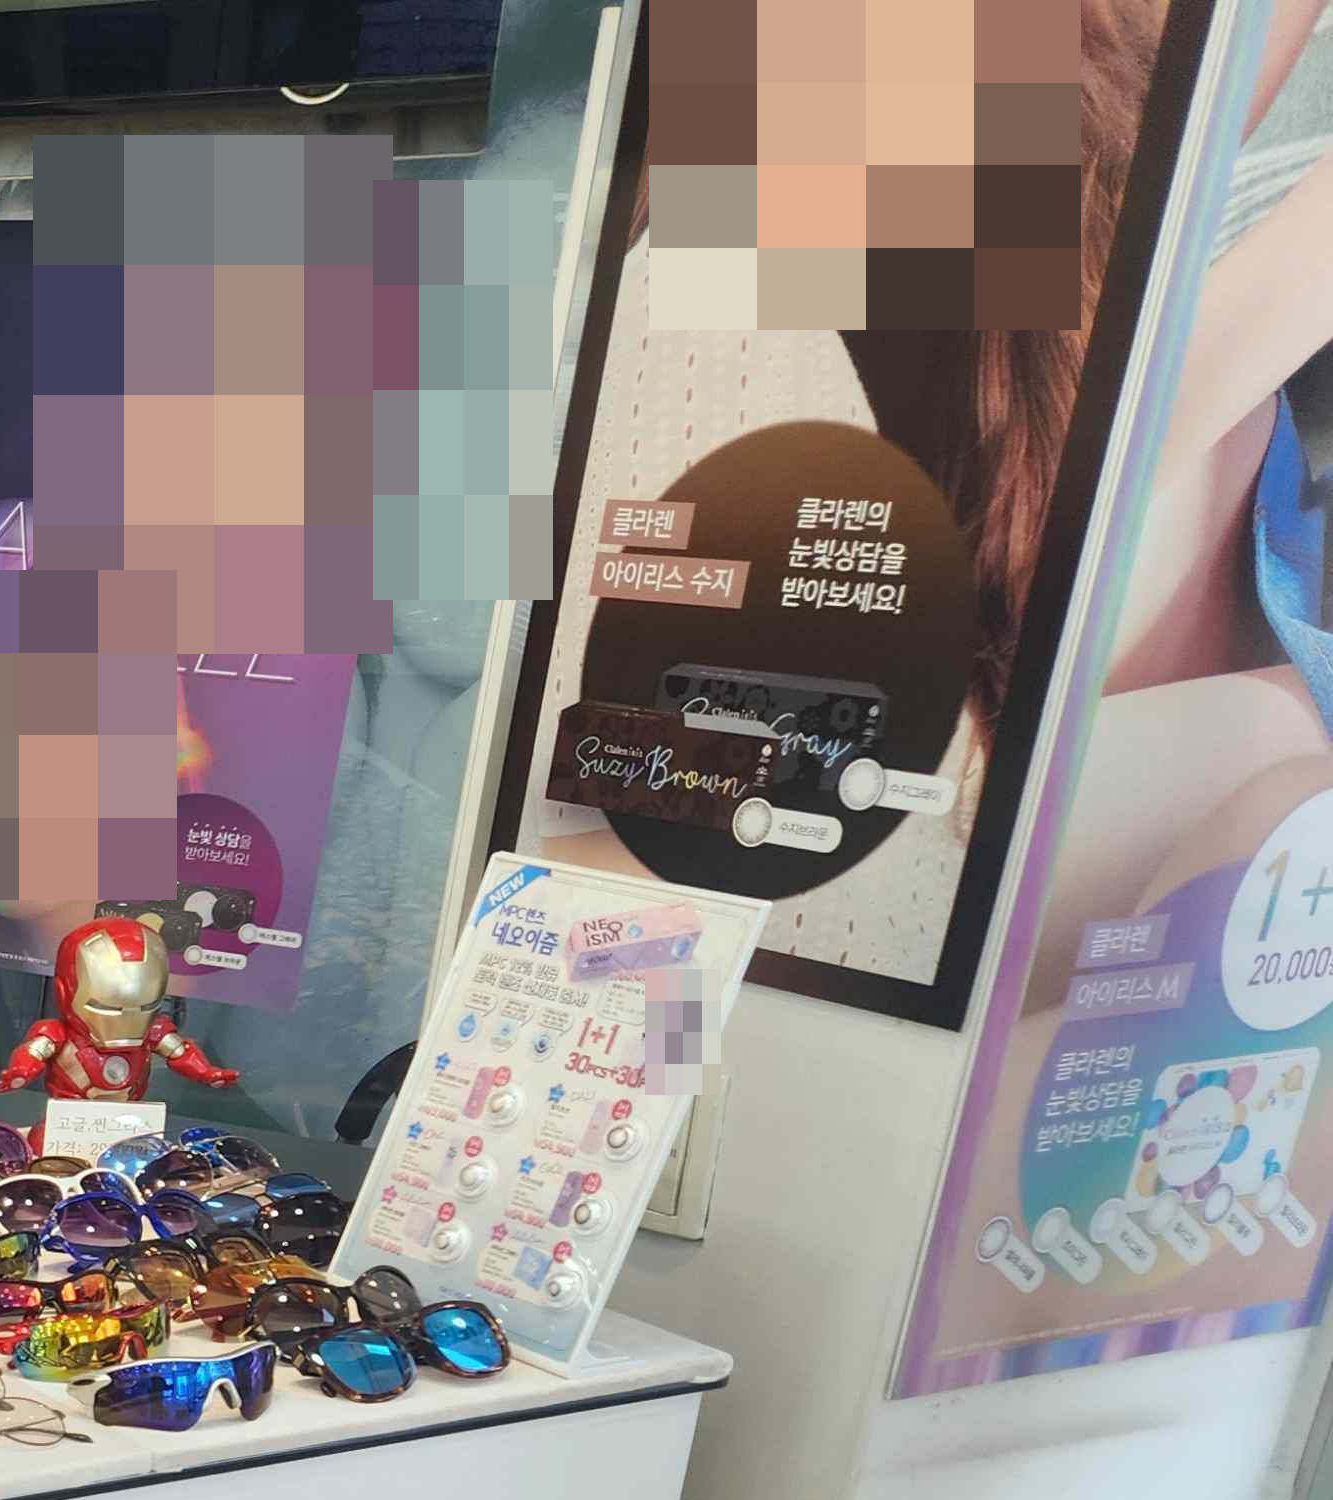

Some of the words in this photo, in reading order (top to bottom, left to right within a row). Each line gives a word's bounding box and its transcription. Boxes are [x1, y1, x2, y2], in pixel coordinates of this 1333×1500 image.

[612, 507, 675, 539] 클라렌
[796, 497, 894, 533] 클라렌의
[788, 537, 908, 575] 눈빛상담을
[602, 560, 683, 591] 아이리스
[691, 567, 735, 598] 수지
[781, 576, 907, 615] 받아보세요!
[644, 745, 748, 799] Brown
[487, 872, 526, 906] NEW
[492, 920, 560, 956] 네오이즘
[1090, 923, 1153, 960] 클라렌
[1076, 979, 1153, 1009] 아이리스
[1055, 1043, 1136, 1082] 클라렌의
[1044, 1077, 1143, 1118] 눈빛상담을
[1035, 1111, 1141, 1154] 받아보세요!
